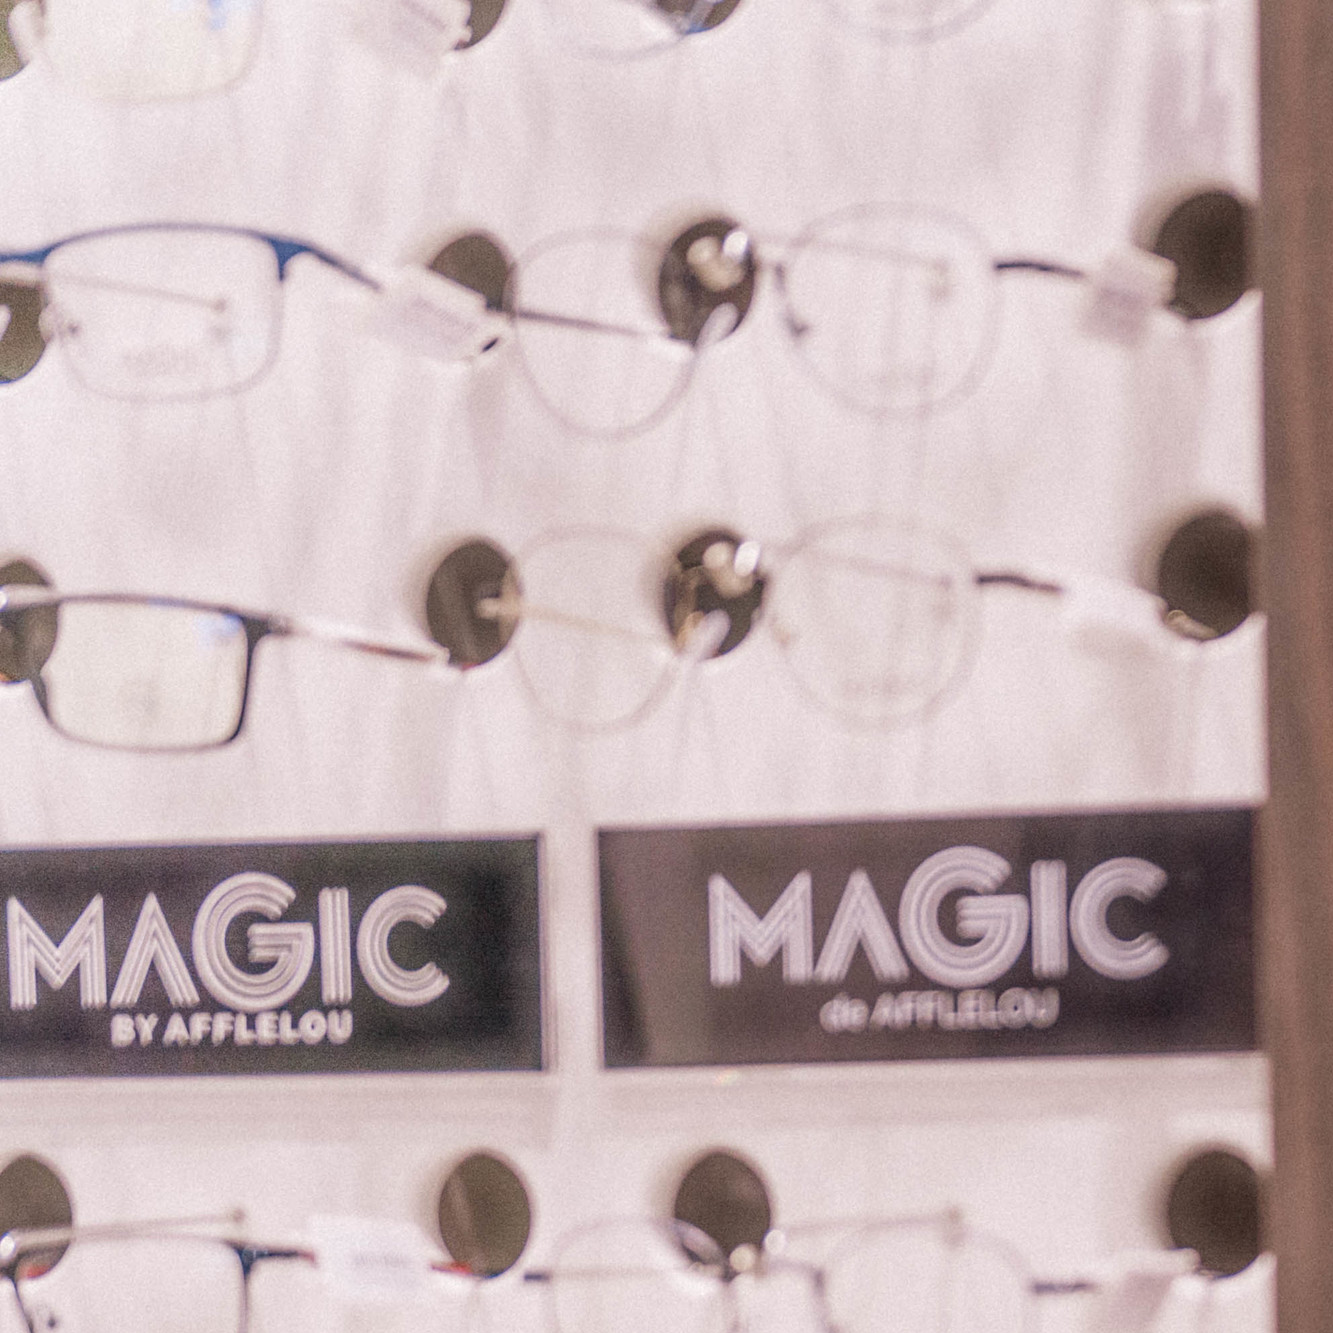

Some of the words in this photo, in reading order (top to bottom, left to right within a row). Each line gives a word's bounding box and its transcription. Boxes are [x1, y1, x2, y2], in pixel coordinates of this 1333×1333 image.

[5, 871, 450, 1011] MAGIC
[707, 845, 1169, 988] MAGIC
[110, 1013, 158, 1047] BY
[162, 1009, 353, 1046] AFFLELOU
